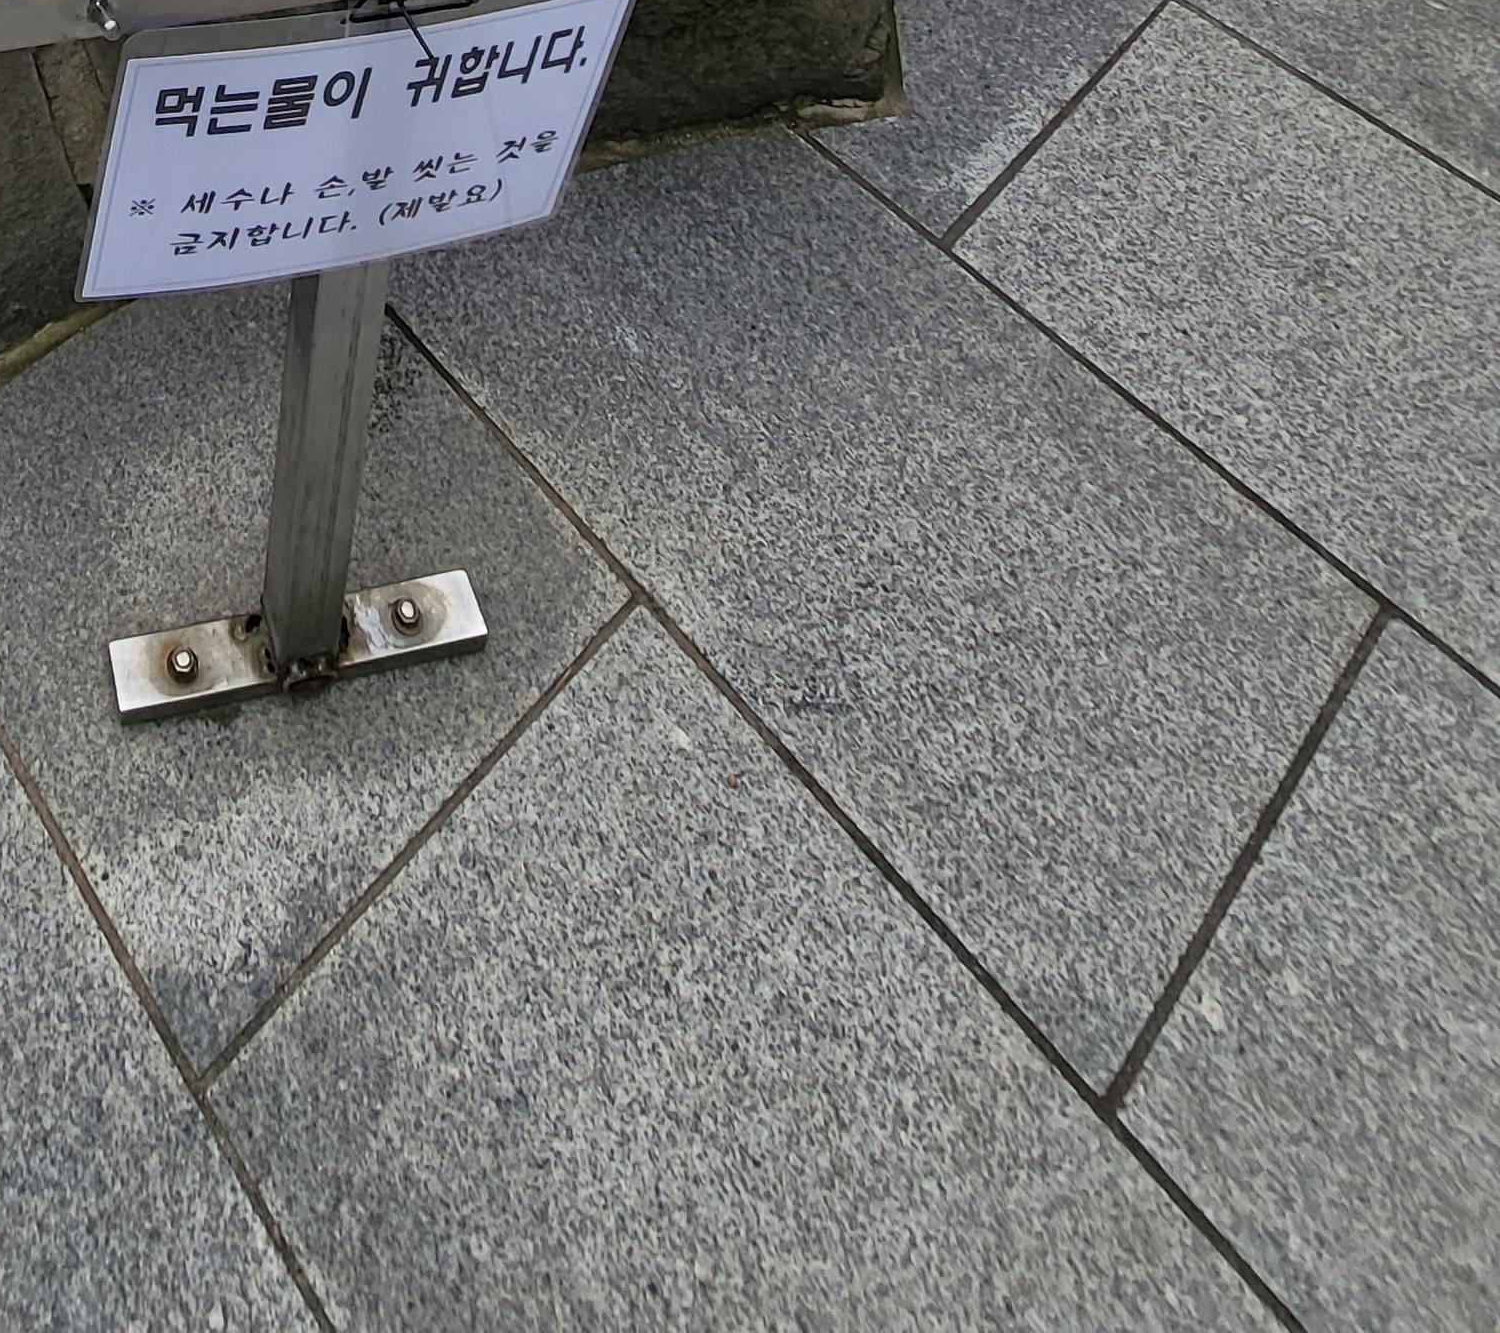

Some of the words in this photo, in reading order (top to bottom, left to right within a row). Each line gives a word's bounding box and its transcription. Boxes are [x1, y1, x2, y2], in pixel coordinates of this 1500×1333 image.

[154, 67, 373, 138] 먹는물이
[406, 25, 587, 107] 귀합니다.
[180, 182, 296, 214] 세수나
[412, 151, 479, 183] 씻는
[495, 130, 560, 164] 것을
[169, 210, 358, 256] 금지합니다.
[378, 178, 504, 227] (제발요)
